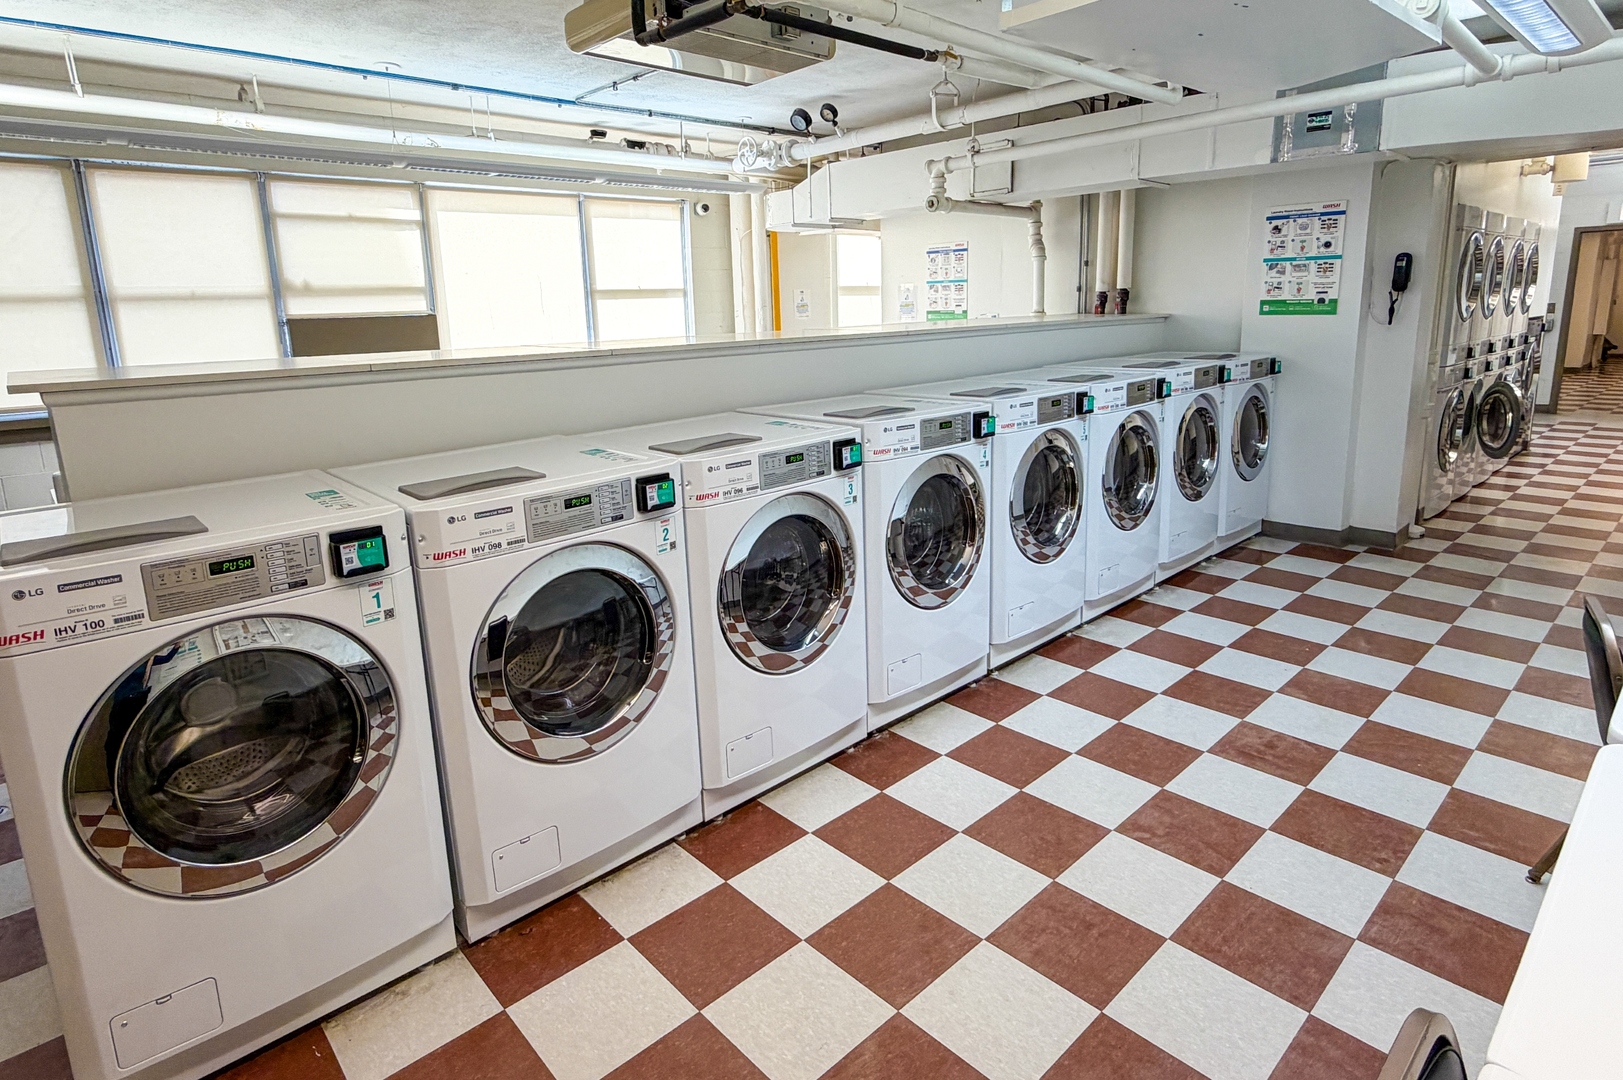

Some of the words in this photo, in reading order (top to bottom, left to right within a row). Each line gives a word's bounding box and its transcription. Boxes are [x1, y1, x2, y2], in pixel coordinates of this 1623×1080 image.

[696, 491, 720, 500] WASH
[848, 484, 853, 495] 3
[572, 496, 589, 506] PUSH
[663, 528, 669, 542] 2
[433, 548, 466, 560] WASH
[472, 545, 485, 554] IHV
[488, 542, 502, 550] 098
[223, 559, 251, 571] PUSH
[60, 580, 97, 592] Commercial
[97, 576, 121, 584] Washer
[28, 588, 44, 597] LG
[372, 592, 381, 609] 1
[67, 604, 87, 614] Direct
[54, 624, 77, 637] IHV
[82, 620, 105, 631] 100
